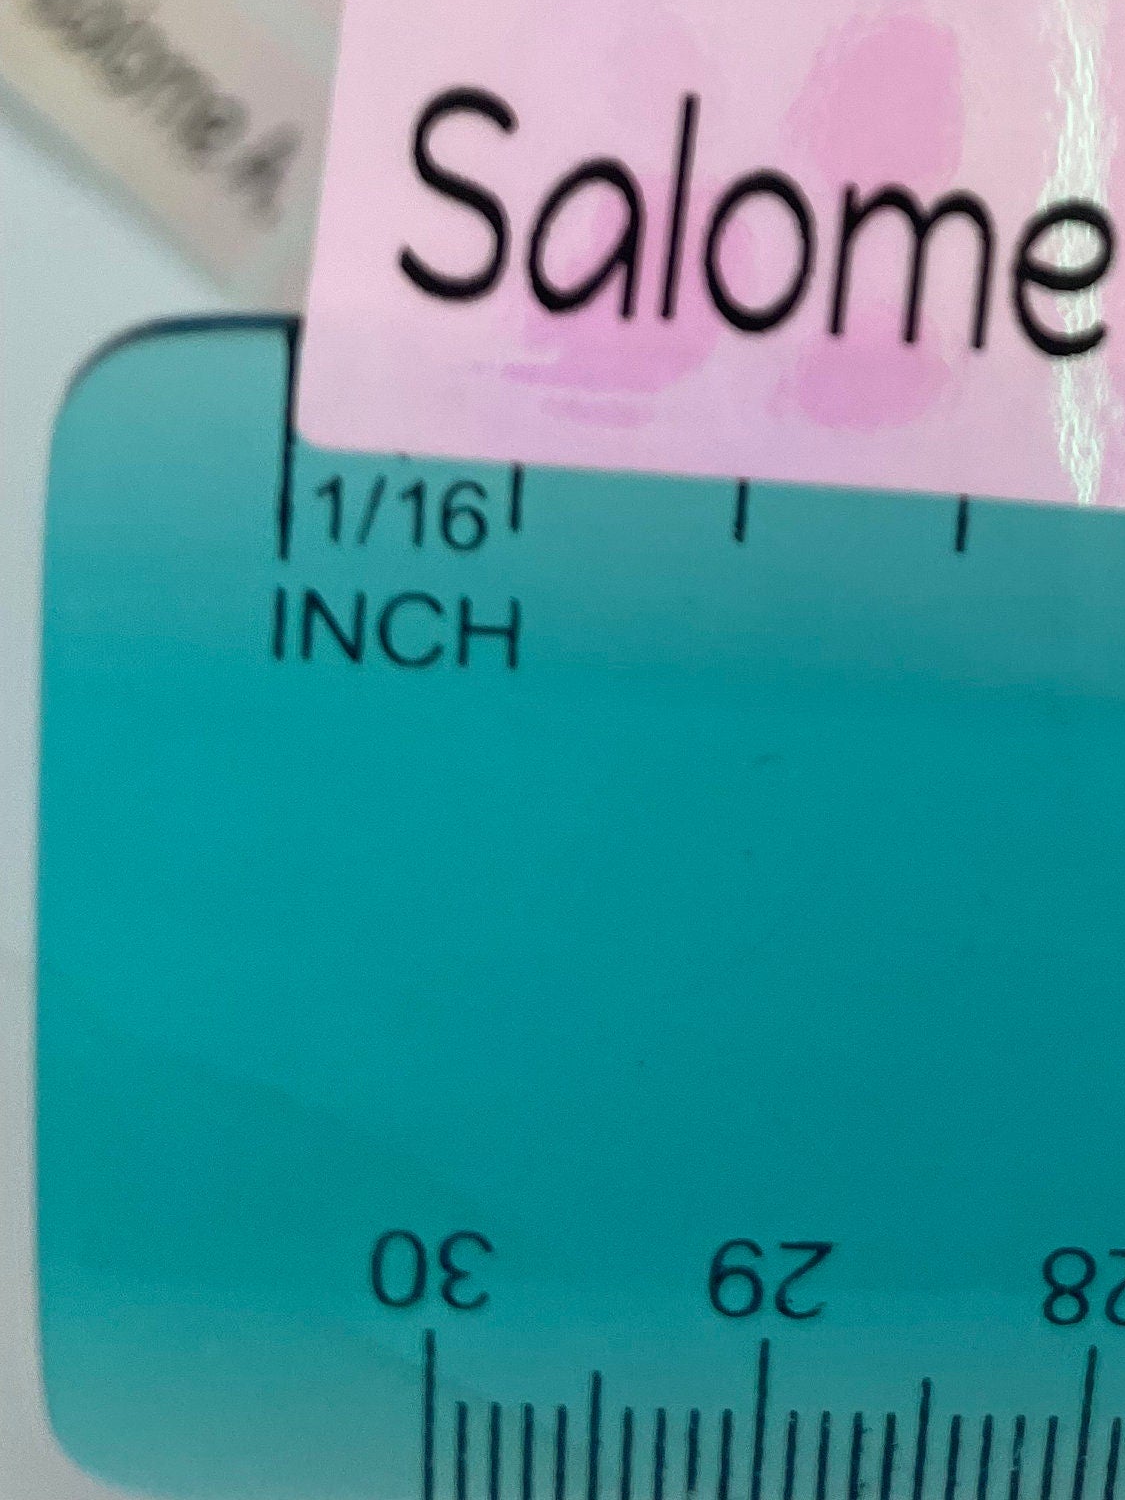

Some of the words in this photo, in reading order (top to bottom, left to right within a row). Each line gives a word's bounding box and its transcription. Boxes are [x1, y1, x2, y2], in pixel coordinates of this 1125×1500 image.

[399, 86, 1114, 356] Salome
[312, 474, 490, 552] 1/16
[270, 586, 522, 670] INCH
[368, 1229, 494, 1311] 30
[707, 1238, 834, 1321] 29
